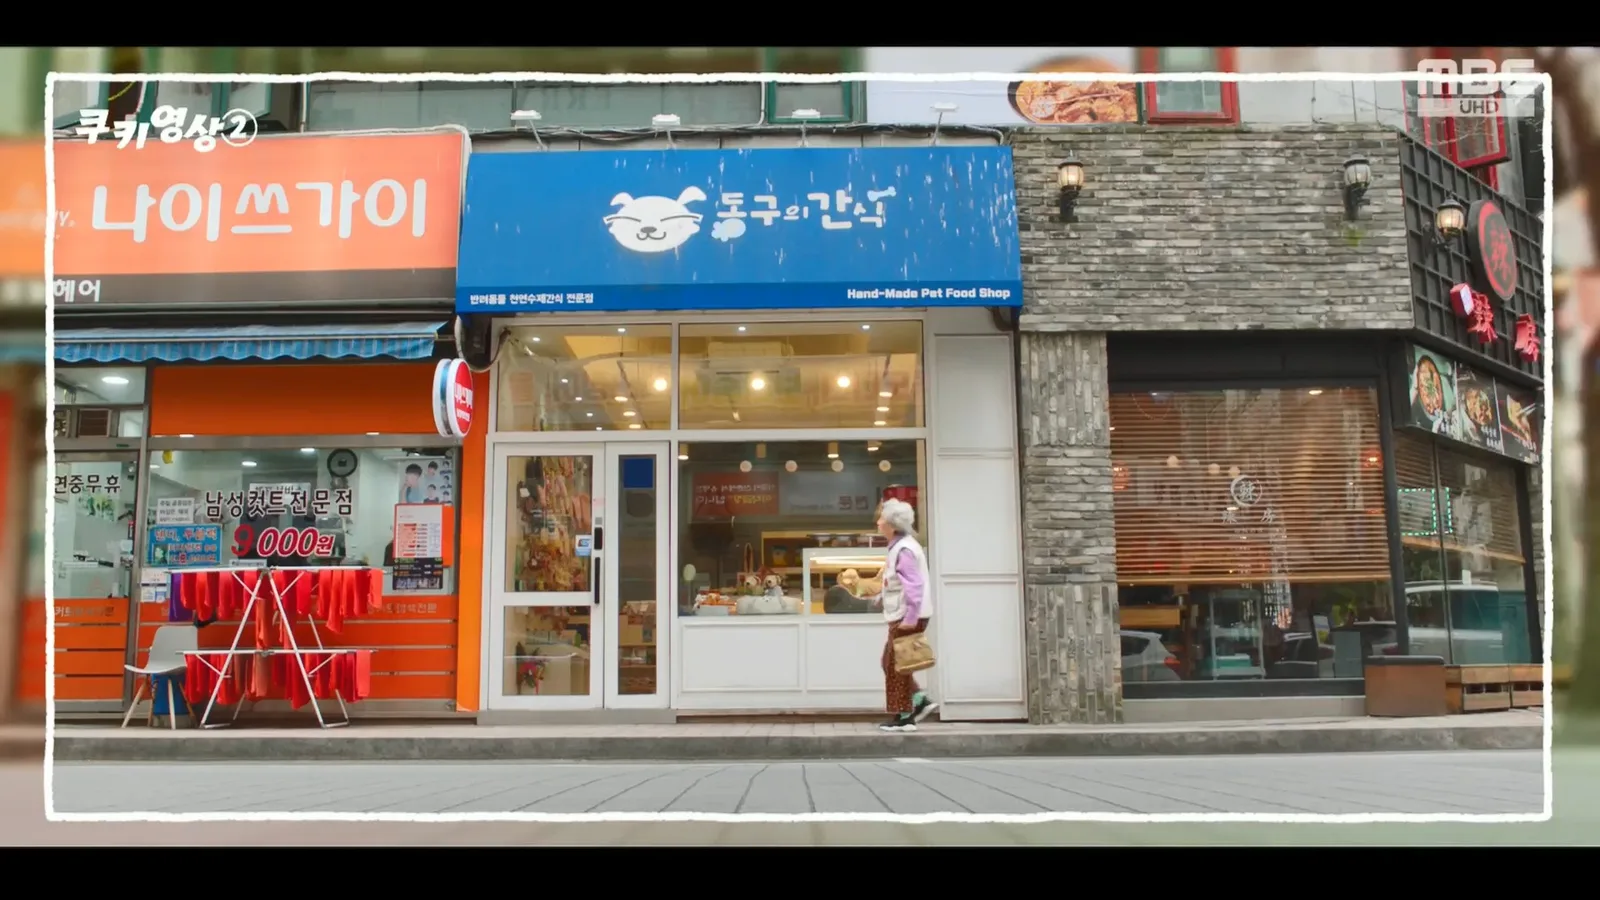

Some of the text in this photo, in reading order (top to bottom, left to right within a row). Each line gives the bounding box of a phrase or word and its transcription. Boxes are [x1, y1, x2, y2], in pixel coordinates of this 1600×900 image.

[92, 178, 427, 243] 나이쓰가이
[711, 189, 884, 242] 동구의 간식
[53, 279, 101, 302] 헤어
[470, 293, 594, 305] 반려동물 천연수제간식 전문점
[847, 288, 1011, 300] Hand-Made Pet Food Shop
[54, 474, 121, 494] 연중무휴
